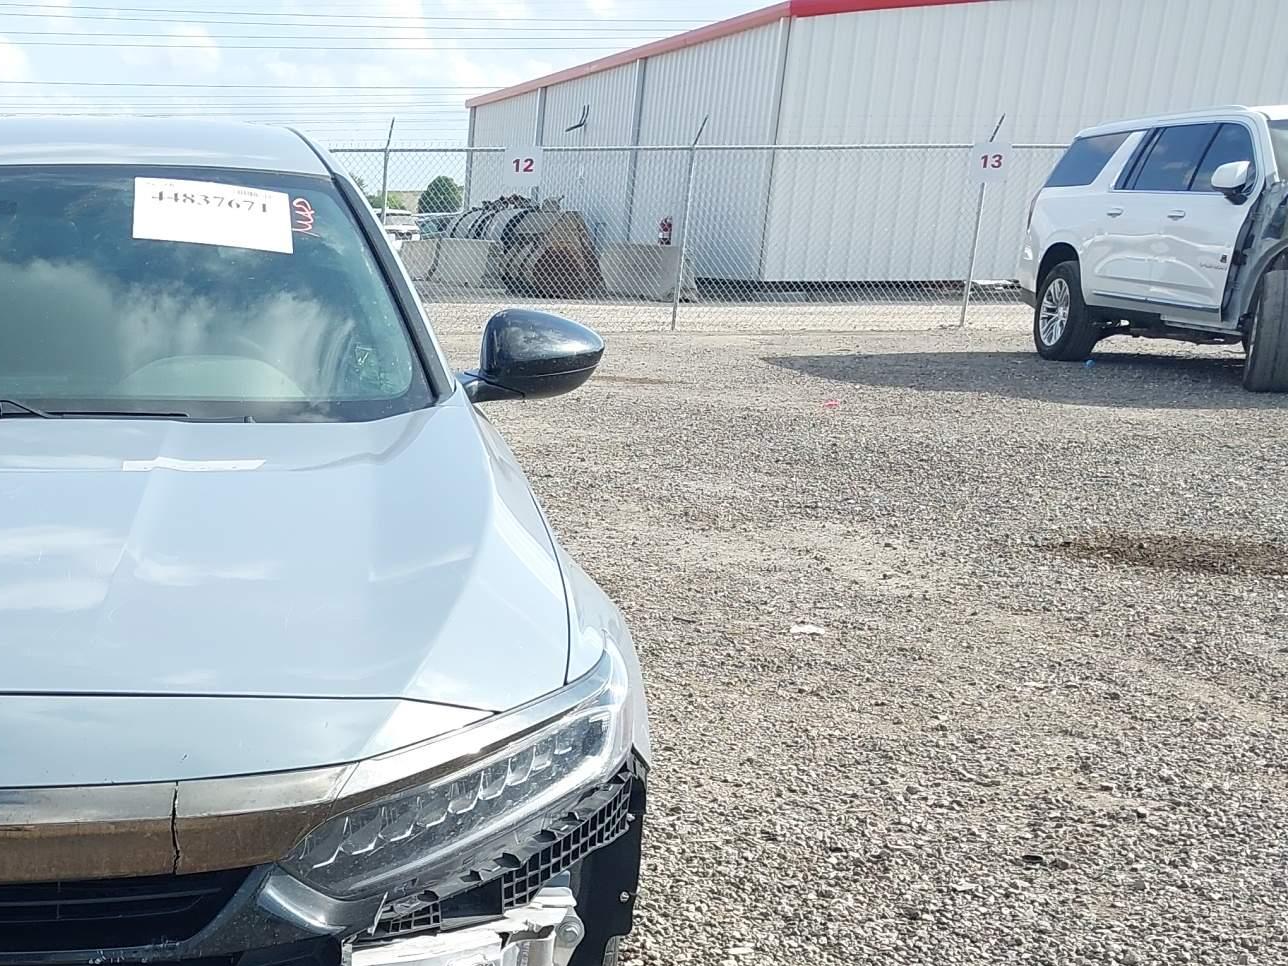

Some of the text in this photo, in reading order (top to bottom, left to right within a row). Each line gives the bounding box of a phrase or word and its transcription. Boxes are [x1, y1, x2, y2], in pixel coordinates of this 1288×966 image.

[512, 158, 534, 172] 12
[981, 154, 1002, 168] 13
[151, 190, 268, 214] 44837671
